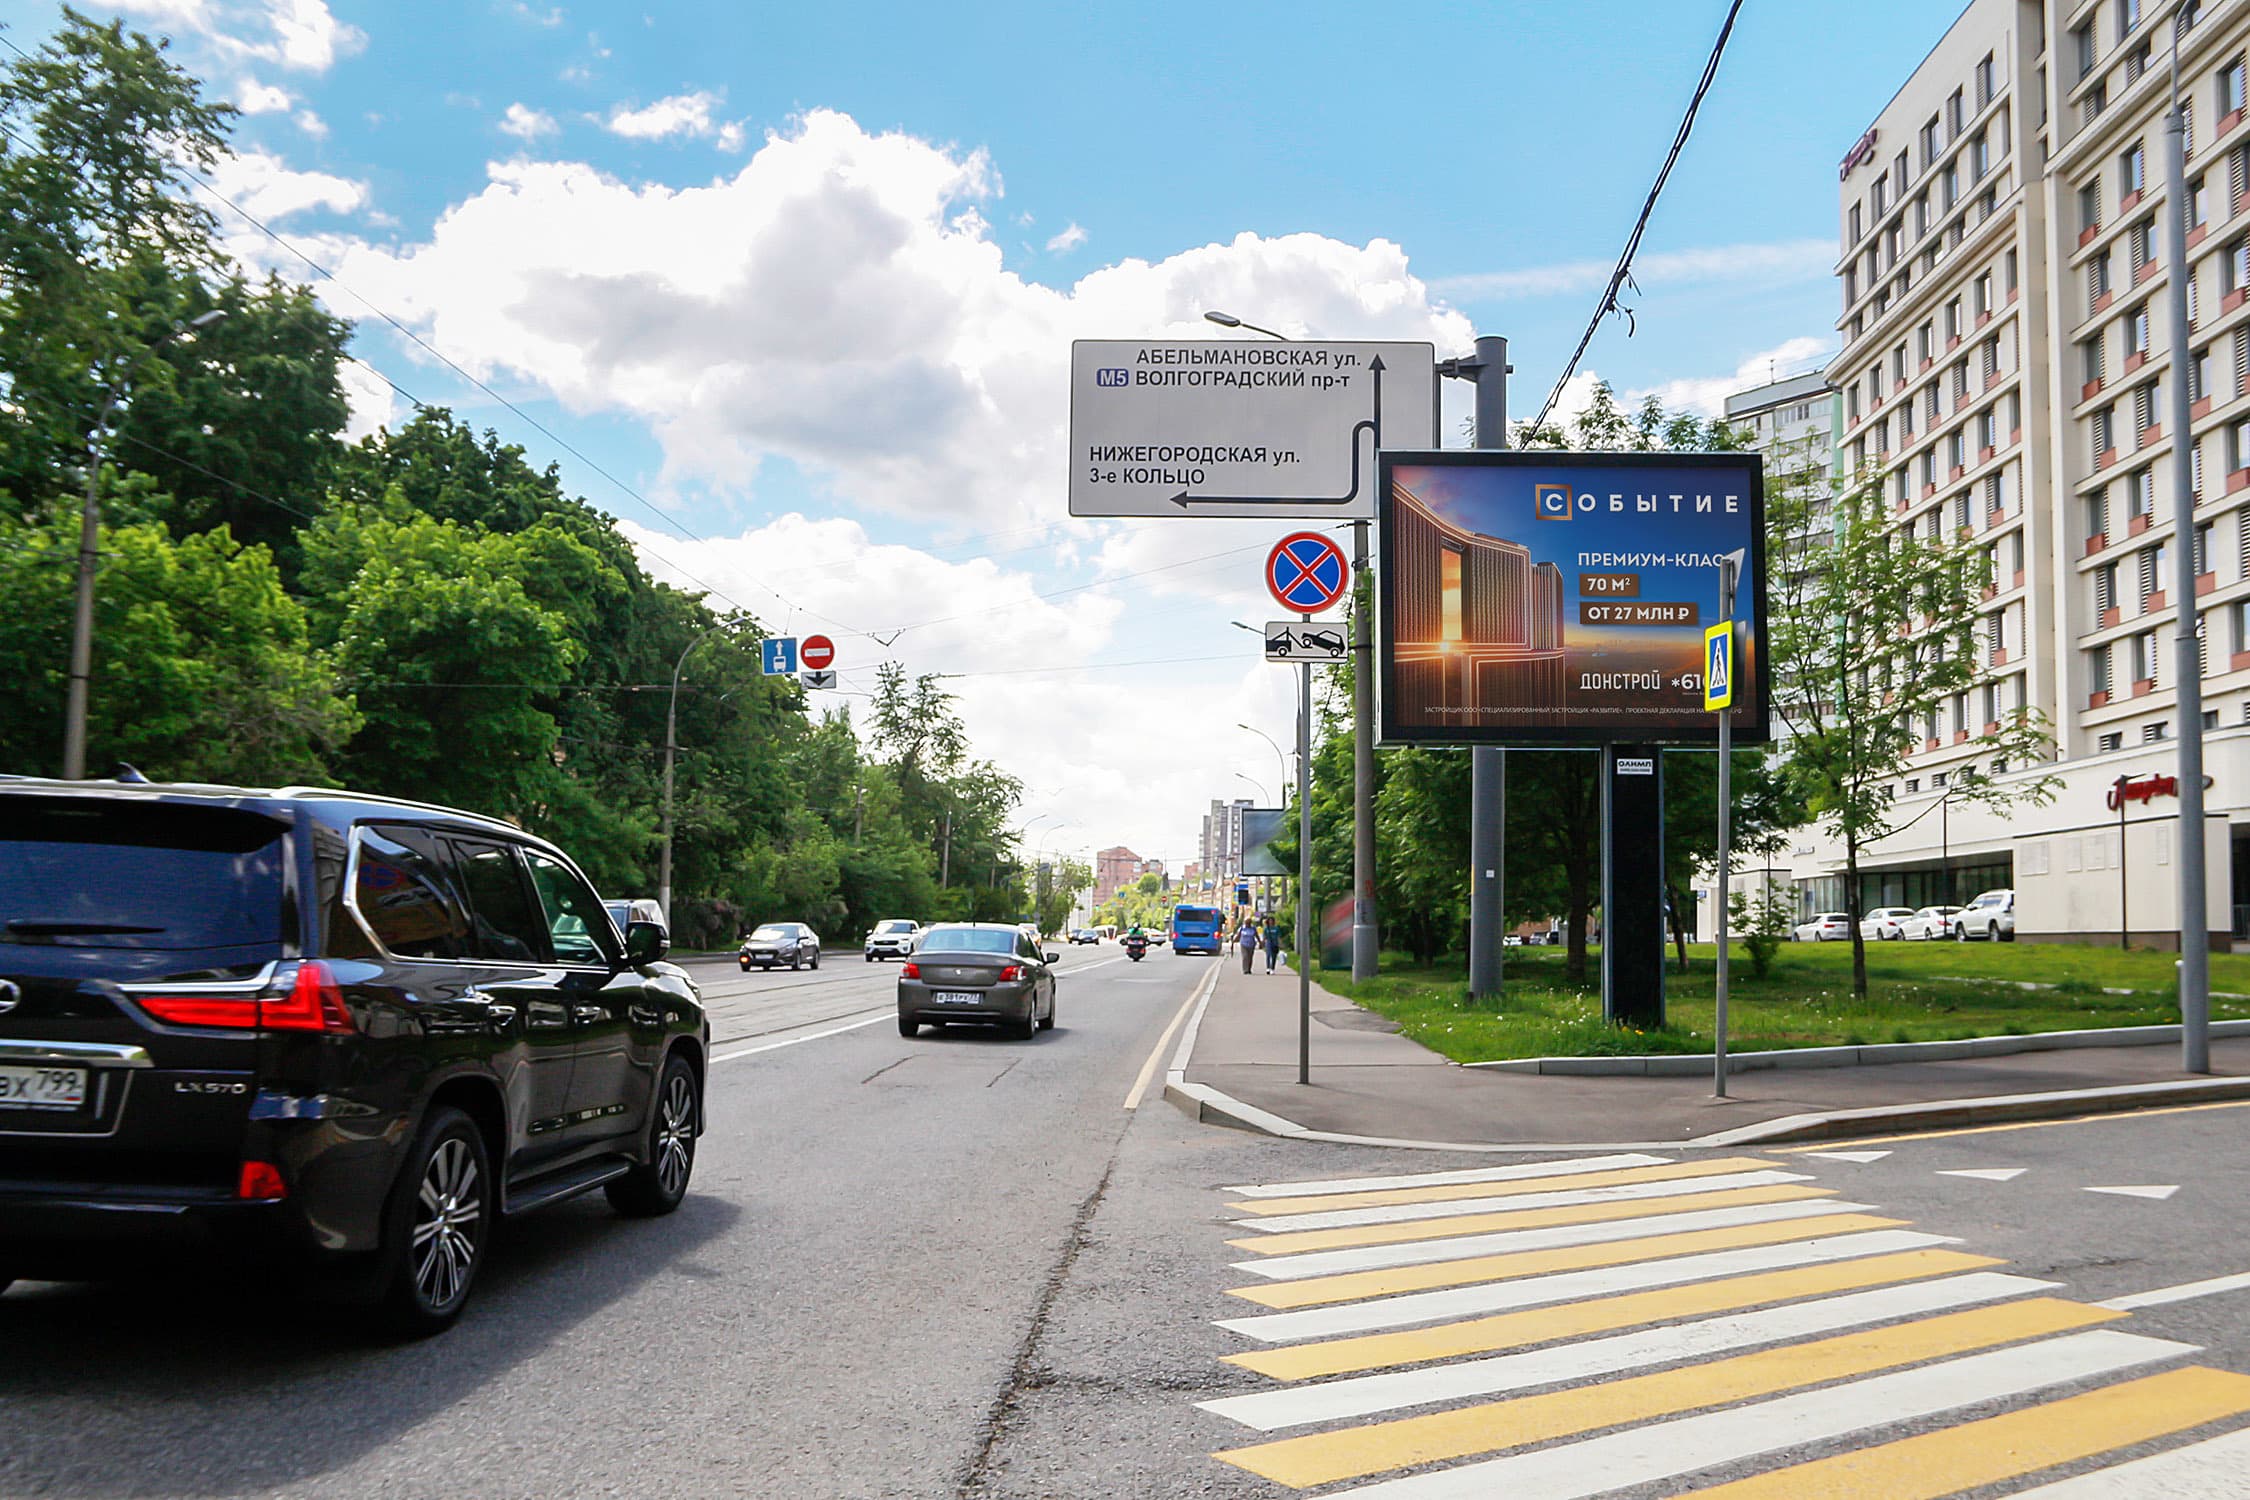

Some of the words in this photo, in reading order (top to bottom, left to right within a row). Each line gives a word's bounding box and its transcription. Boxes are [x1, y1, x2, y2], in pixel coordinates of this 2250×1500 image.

[1136, 349, 1328, 365] АБЕЛЬМАНОВСКАЯ
[1334, 354, 1361, 369] ул.
[1100, 370, 1127, 386] М5
[1136, 368, 1304, 389] ВОЛГОГРАДСКИЙ
[1311, 375, 1350, 390] пр-т
[1089, 446, 1267, 465] НИЖЕГОРОДСКАЯ
[1272, 451, 1300, 466] ул.
[1089, 468, 1117, 483] 3-е
[1123, 468, 1205, 487] КОЛЬЦО
[1545, 493, 1739, 513] СОБЫТИЕ
[1578, 552, 1723, 567] ПРЕМИУМ-КЛАС
[1587, 578, 1607, 591] 70
[1588, 607, 1610, 620] ОТ
[1614, 607, 1632, 620] 27
[1637, 607, 1674, 620] МЛН
[1579, 670, 1661, 690] ДОНСТРОЙ
[36, 1070, 78, 1092] 799
